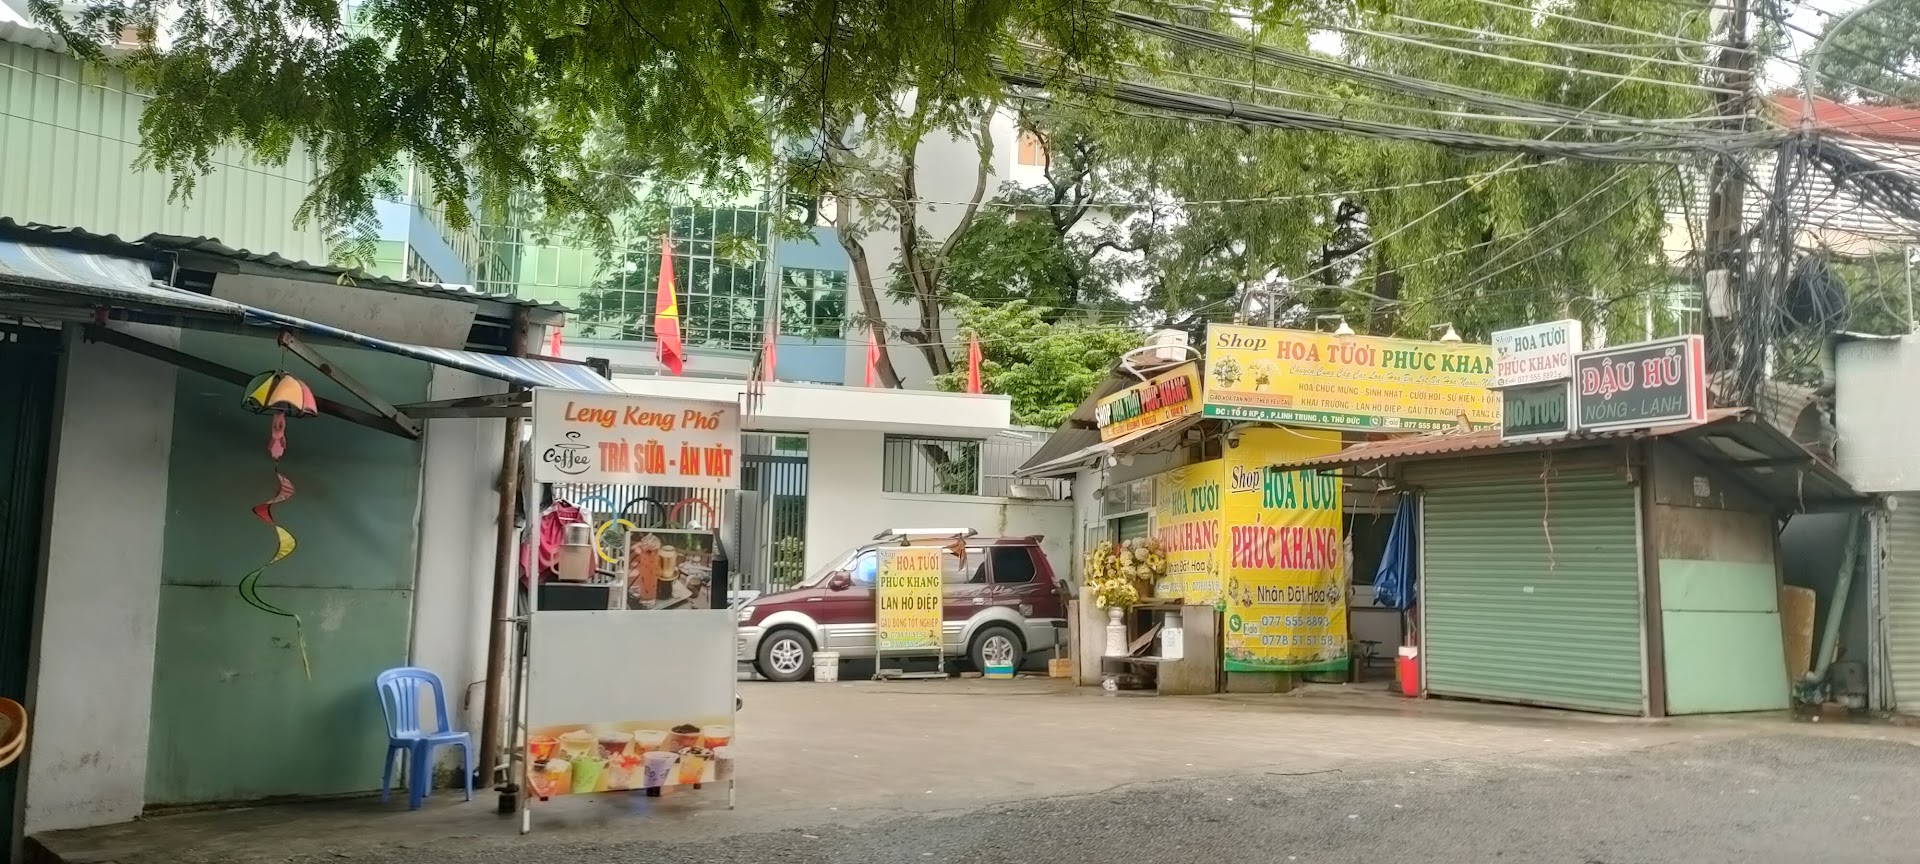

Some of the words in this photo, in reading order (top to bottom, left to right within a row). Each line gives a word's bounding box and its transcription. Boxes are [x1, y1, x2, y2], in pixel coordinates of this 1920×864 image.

[1216, 333, 1267, 350] Shop
[1514, 335, 1537, 352] HOA
[1539, 326, 1566, 348] TƯƠI
[1276, 340, 1320, 362] HOA
[1327, 342, 1376, 366] TƯƠI
[1382, 346, 1436, 372] PHÚC
[1498, 356, 1526, 376] PHÚC
[1528, 352, 1567, 372] KHANG
[1581, 353, 1636, 400] ĐẬU
[1641, 346, 1683, 389] HŨ
[1095, 402, 1111, 429] SHOP
[1111, 398, 1126, 423] HOA
[1160, 376, 1188, 406] KHANG
[1298, 382, 1314, 391] HOA
[1316, 382, 1336, 392] CHÚC
[1365, 388, 1382, 397] SINH
[1447, 392, 1458, 403] SỰ
[1301, 397, 1318, 406] KHAI
[1356, 402, 1370, 411] LAN
[564, 401, 618, 428] Leng
[623, 406, 676, 432] Keng
[681, 409, 725, 431] Phố
[1242, 409, 1247, 417] 6
[1294, 413, 1316, 422] TRUNG
[1506, 399, 1532, 428] HOA
[1586, 397, 1628, 421] NÓNG
[1640, 394, 1682, 418] LẠNH
[543, 448, 590, 466] Coffee
[598, 438, 630, 473] TRÀ
[634, 438, 666, 476] SỮA
[680, 440, 700, 476] ĂN
[704, 444, 732, 482] VẶT
[1172, 489, 1188, 517] HOA
[1191, 479, 1220, 513] TƯƠI
[1231, 465, 1260, 492] Shop
[1263, 468, 1296, 509] HOA
[1180, 520, 1219, 552] KHANG
[1231, 512, 1276, 569] PHÚC
[1280, 526, 1337, 570] KHANG
[897, 556, 916, 570] HOA
[1192, 561, 1205, 571] Hoa
[880, 574, 904, 588] PHÚC
[907, 576, 939, 588] KHANG
[881, 597, 898, 610] LAN
[917, 593, 938, 612] ĐIỆP
[1257, 586, 1284, 602] Nhận
[1288, 585, 1306, 603] Đặt
[1307, 586, 1325, 602] Hoa
[1261, 616, 1281, 626] 077
[1284, 616, 1303, 627] 555
[1306, 616, 1330, 627] 8893
[1262, 635, 1288, 646] 0778
[1292, 636, 1302, 646] 51
[1306, 636, 1316, 646] 51
[1321, 636, 1334, 646] 58
